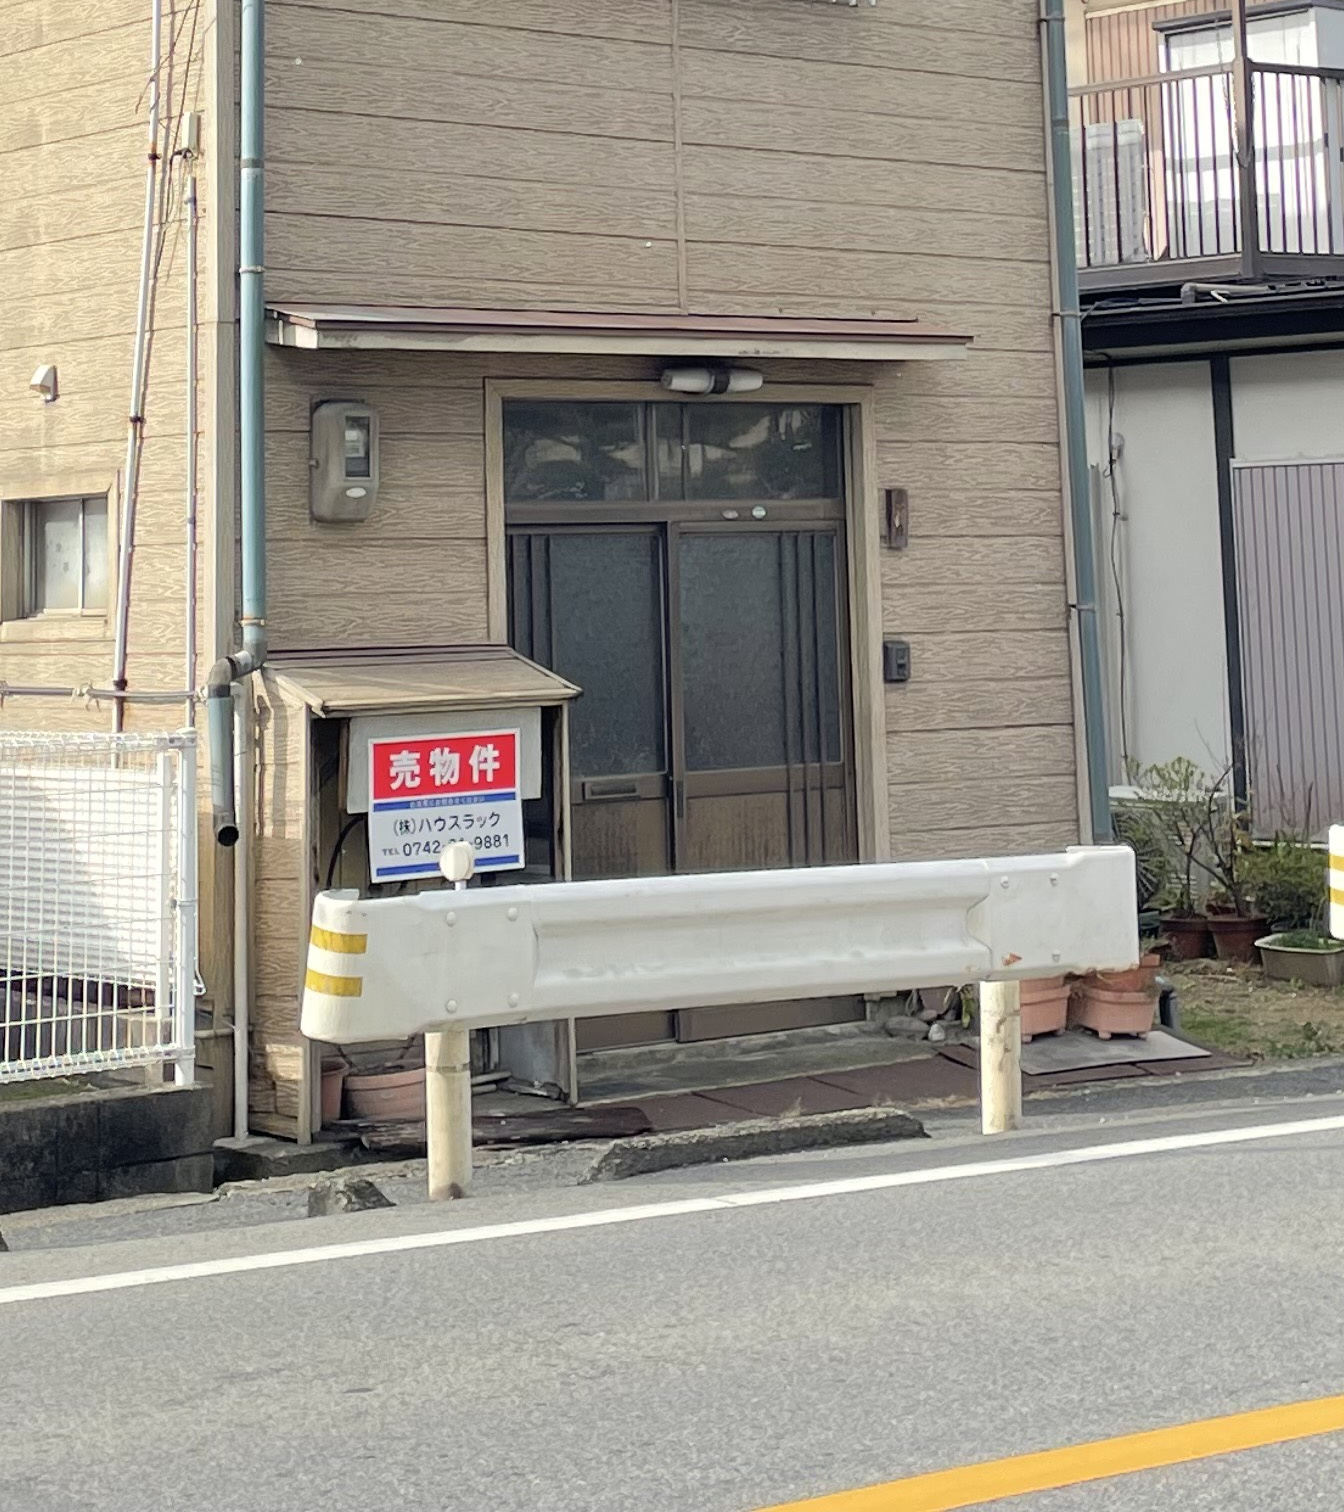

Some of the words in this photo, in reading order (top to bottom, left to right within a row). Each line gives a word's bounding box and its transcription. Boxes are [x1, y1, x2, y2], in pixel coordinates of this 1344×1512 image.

[389, 744, 500, 790] 売物件
[382, 848, 400, 857] TEL
[402, 833, 509, 856] 0742--9881
